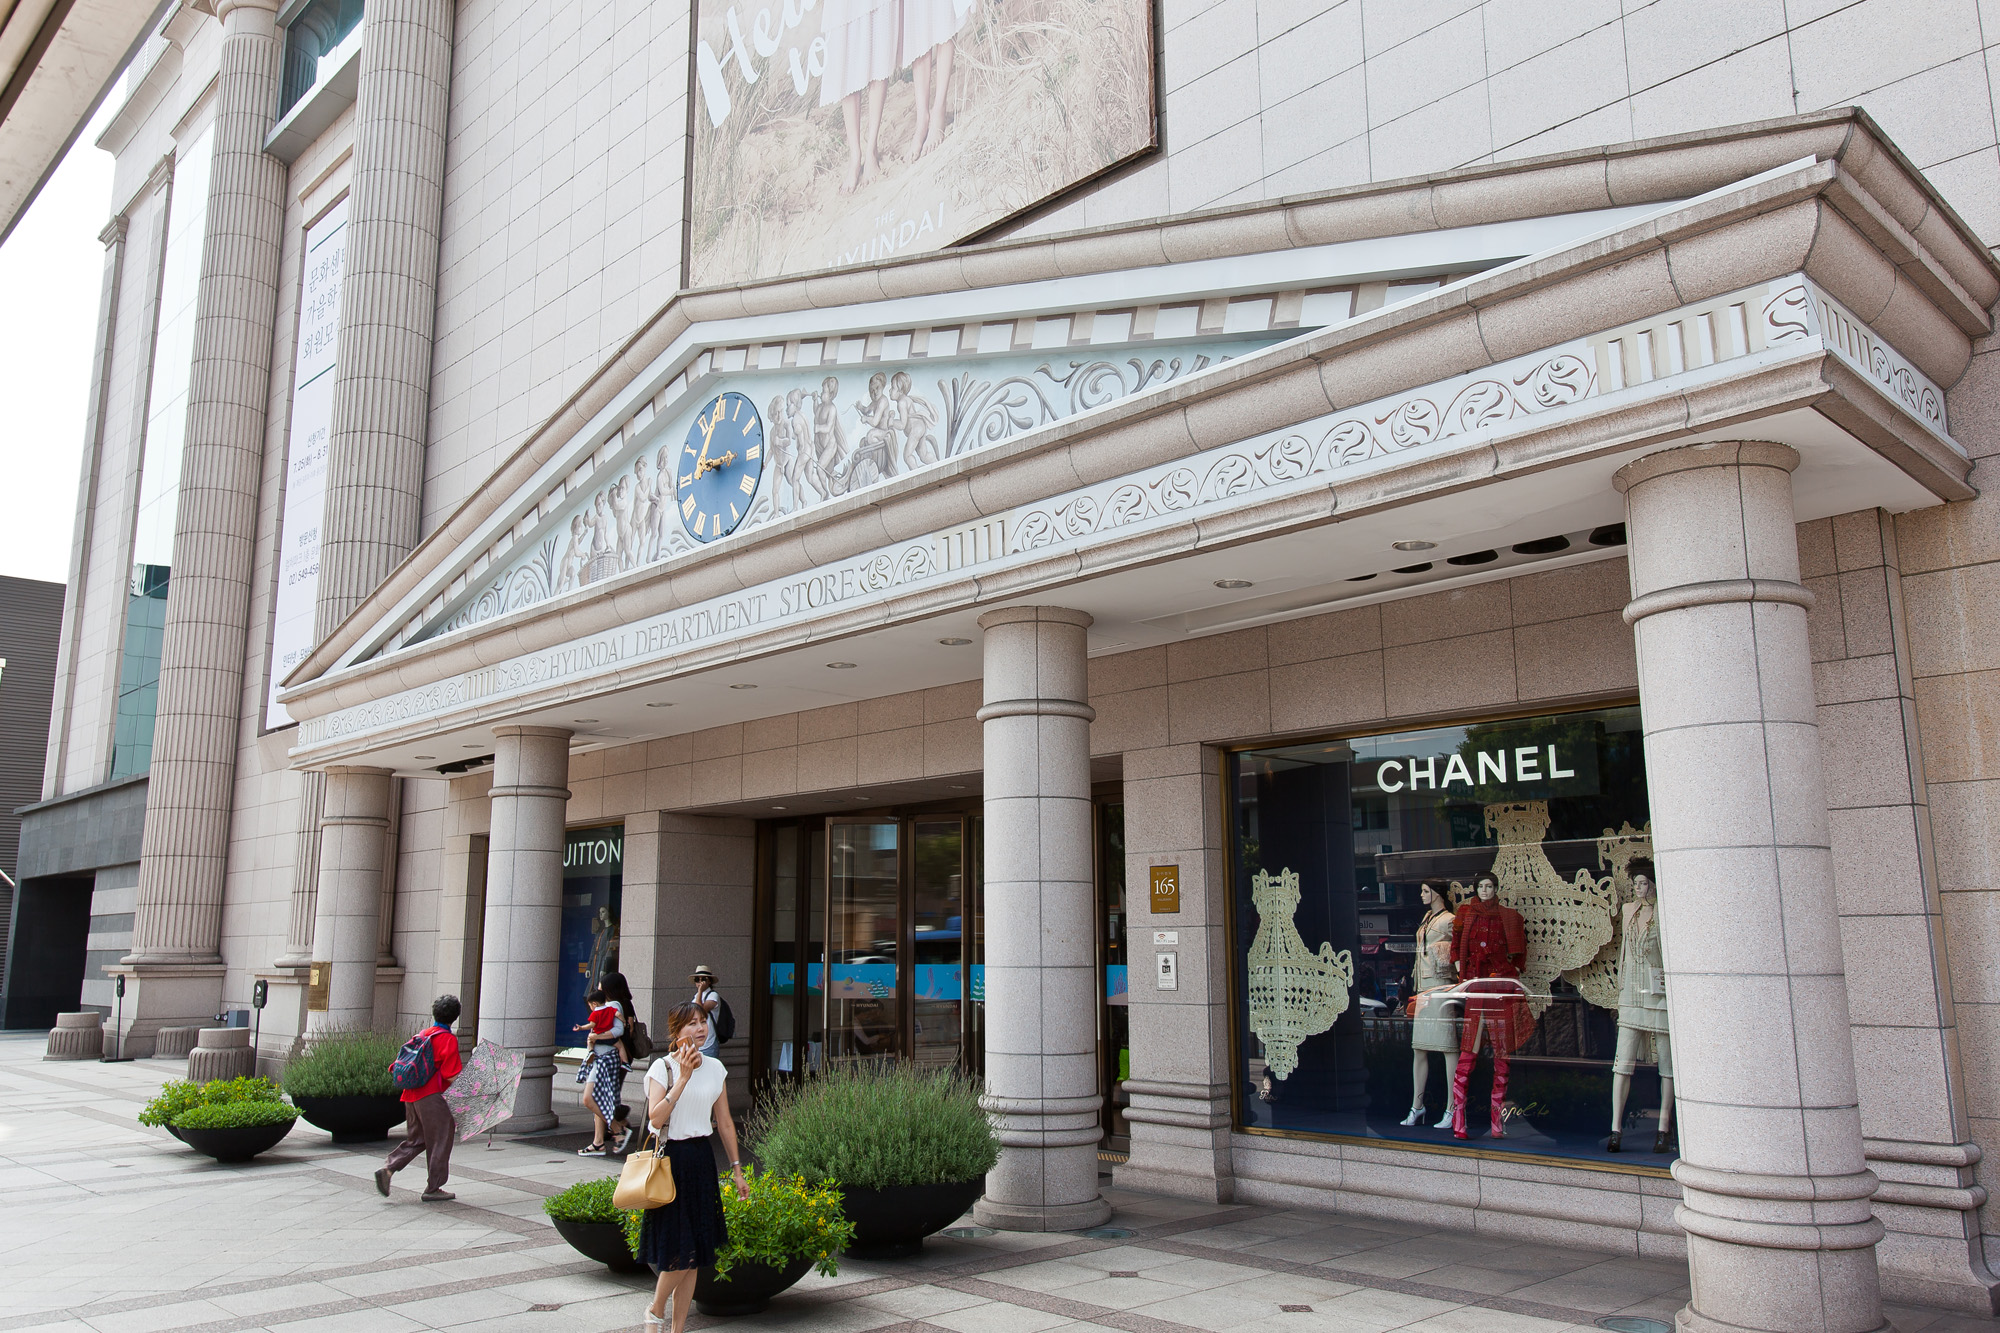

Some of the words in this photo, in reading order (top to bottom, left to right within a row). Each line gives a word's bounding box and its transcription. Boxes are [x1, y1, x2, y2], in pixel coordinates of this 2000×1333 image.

[875, 208, 897, 229] THE
[549, 633, 628, 680] HYUNDAI
[635, 593, 768, 657] DEPARTMENT
[779, 567, 856, 617] STORE
[1376, 744, 1575, 793] CHANEL
[1154, 876, 1175, 896] 165
